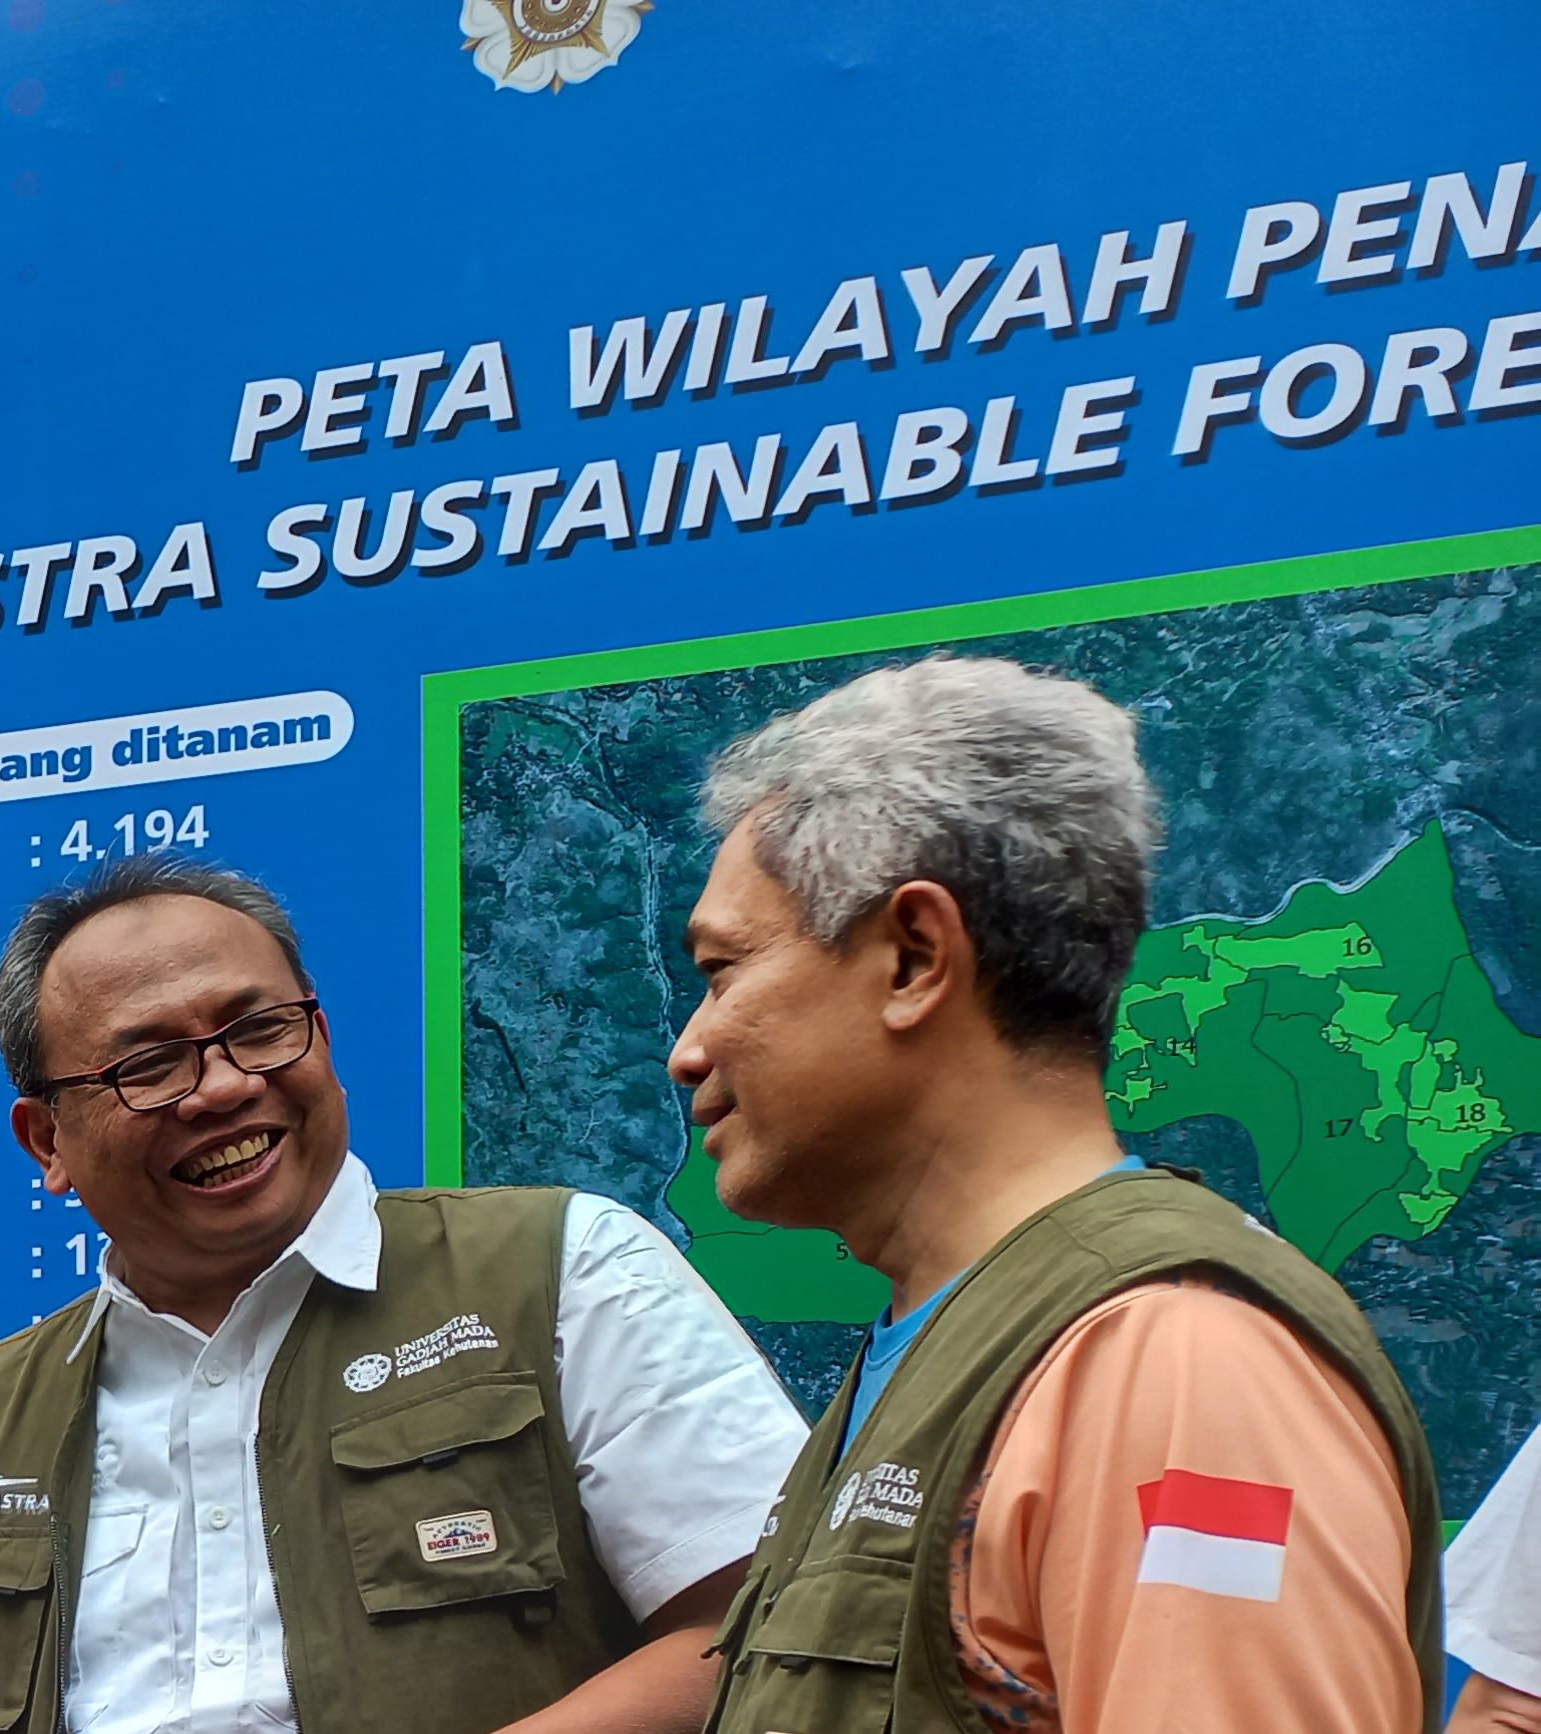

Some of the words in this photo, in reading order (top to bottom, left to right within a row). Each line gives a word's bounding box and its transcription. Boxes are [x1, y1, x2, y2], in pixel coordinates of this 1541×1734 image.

[229, 341, 514, 463] PETA
[568, 220, 1188, 410] WILAYAH
[1227, 161, 1541, 299] PEN
[257, 376, 1135, 590] SUSTAINABLE
[1173, 311, 1541, 456] FORE
[111, 712, 332, 767] ditanam
[1341, 935, 1372, 957] 16
[1170, 1036, 1197, 1056] 14
[1323, 1117, 1354, 1139] 17
[1455, 1102, 1486, 1124] 18
[394, 1313, 481, 1357] UNIVERSITAS
[396, 1337, 448, 1367] GADJAH
[450, 1324, 497, 1342] MADA
[869, 1480, 925, 1509] MADA
